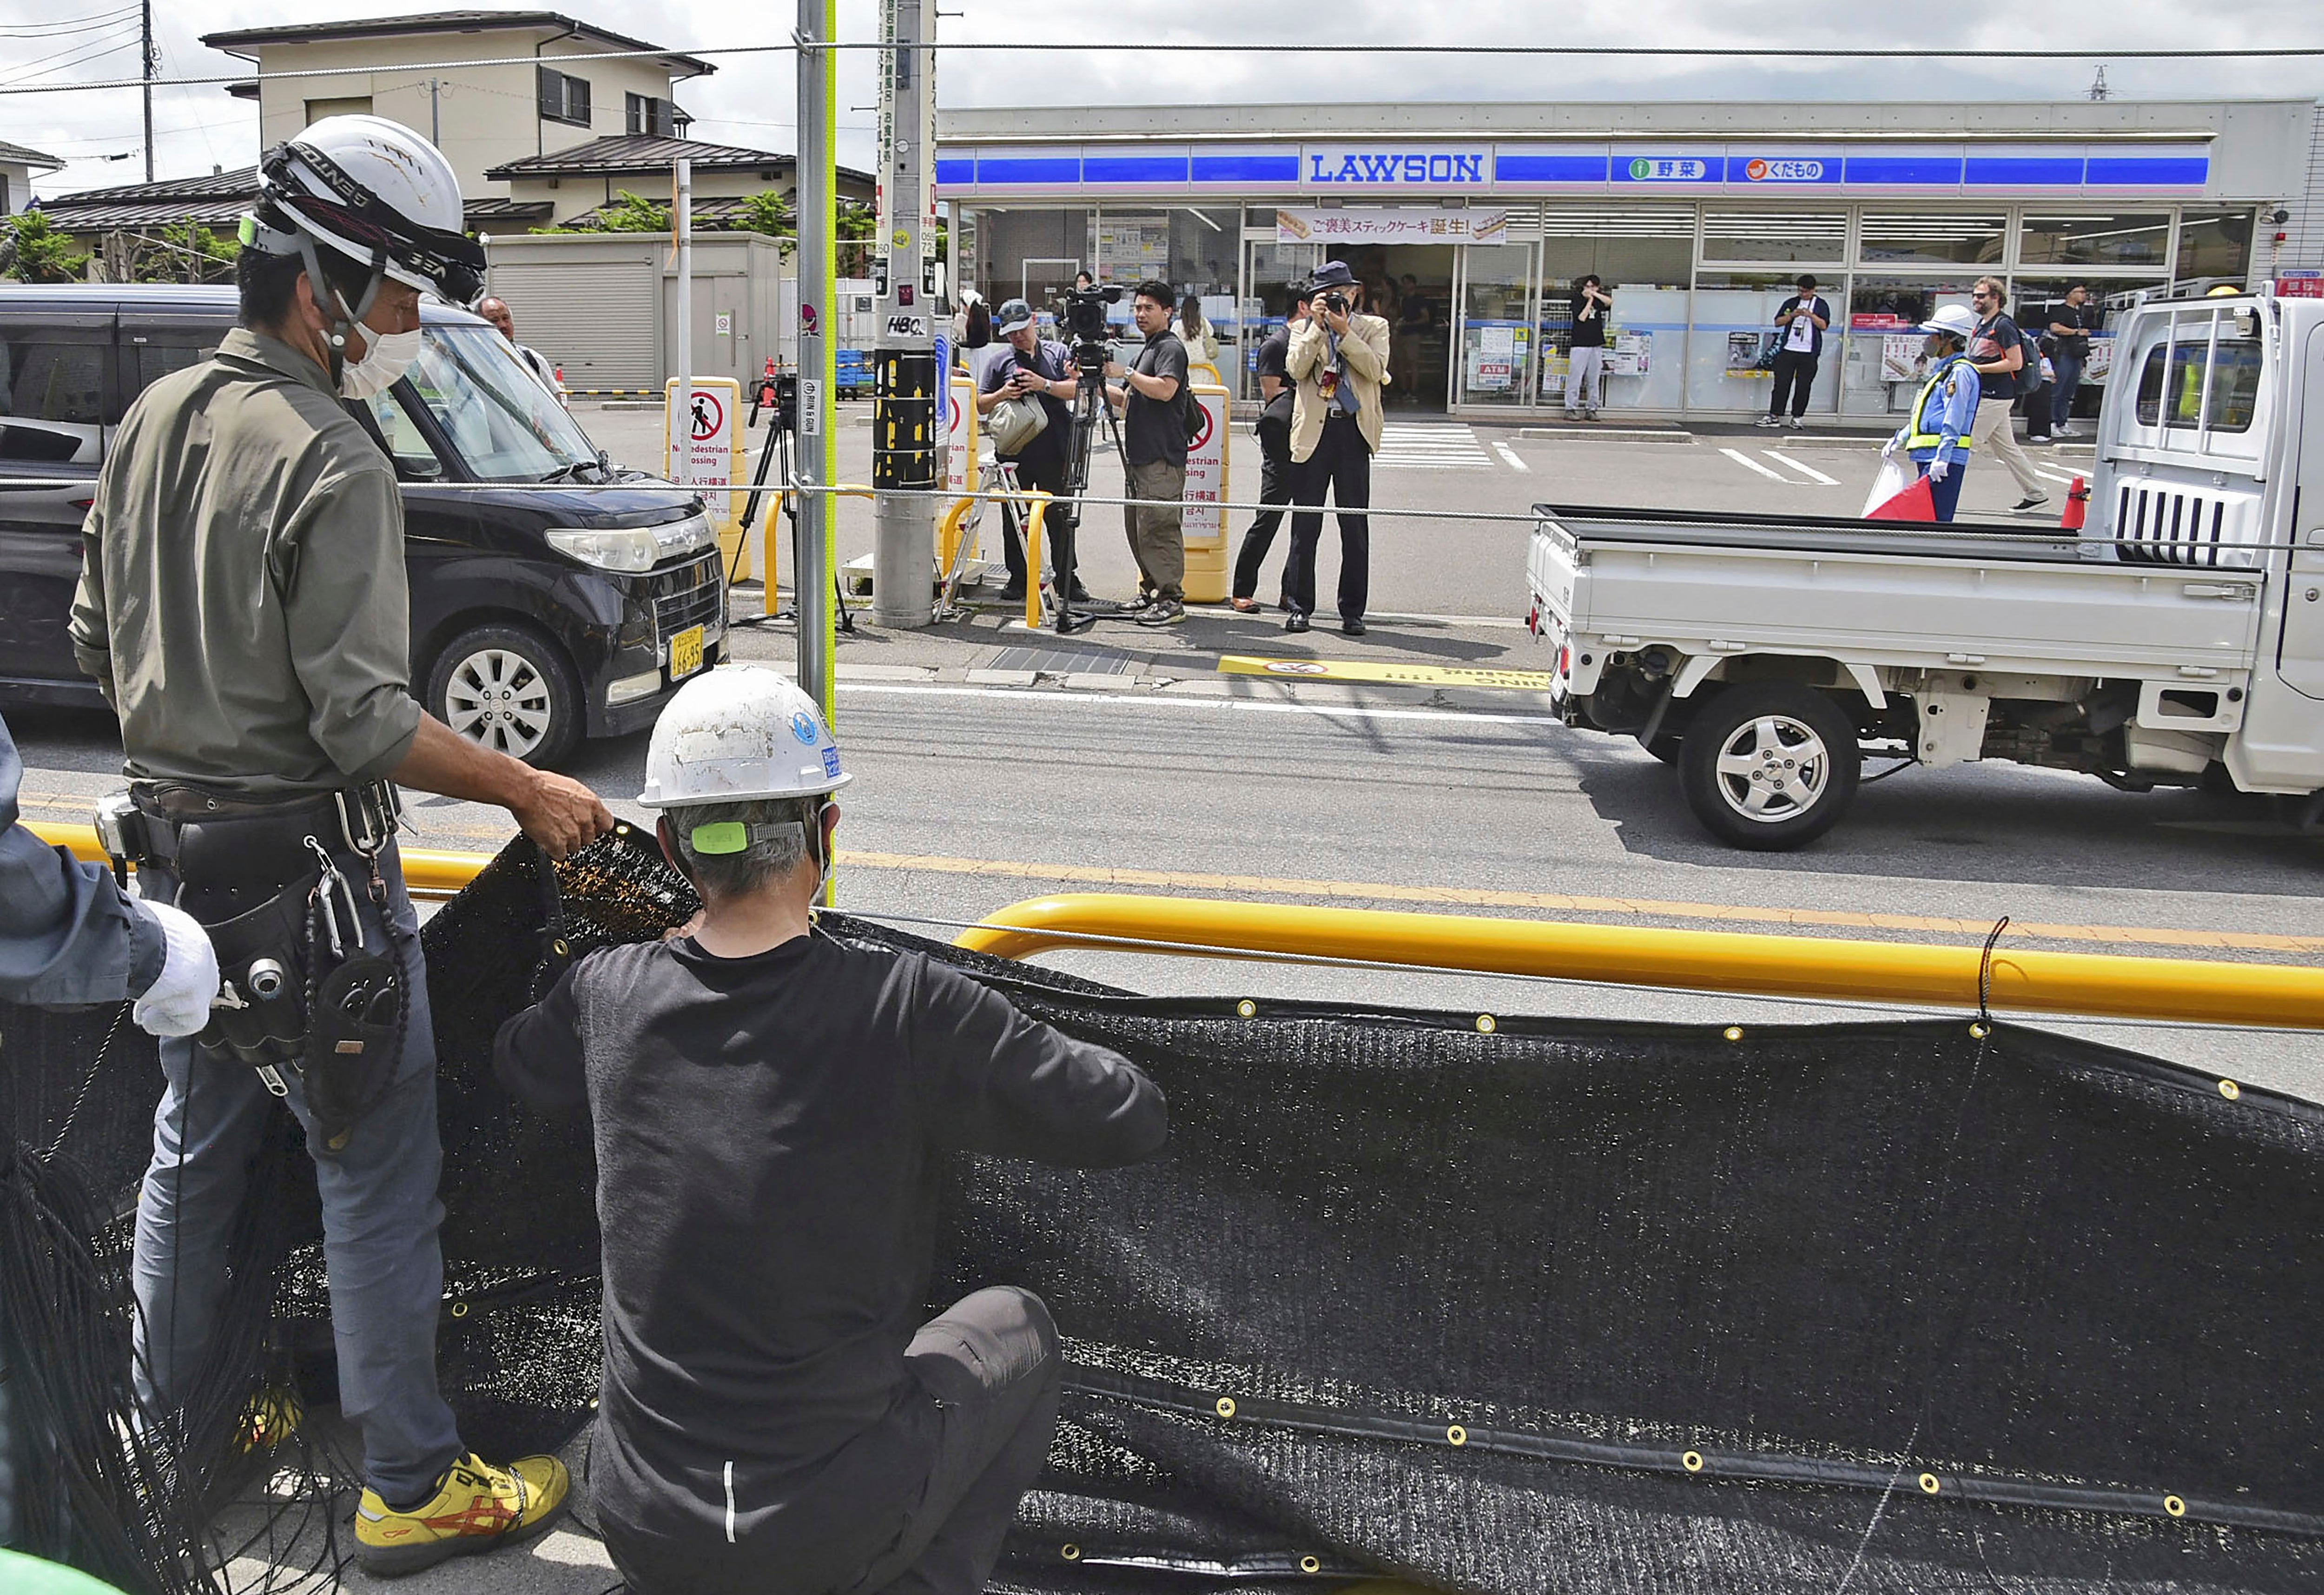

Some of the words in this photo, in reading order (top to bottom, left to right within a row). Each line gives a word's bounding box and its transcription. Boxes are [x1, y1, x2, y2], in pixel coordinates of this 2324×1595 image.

[1310, 154, 1483, 182] LAWSON
[1657, 162, 1695, 177] 野菜
[1770, 163, 1818, 178] くだもの
[805, 418, 814, 432] GUN
[691, 445, 728, 453] edestrian
[691, 456, 716, 466] ossing
[1186, 457, 1219, 465] estrian
